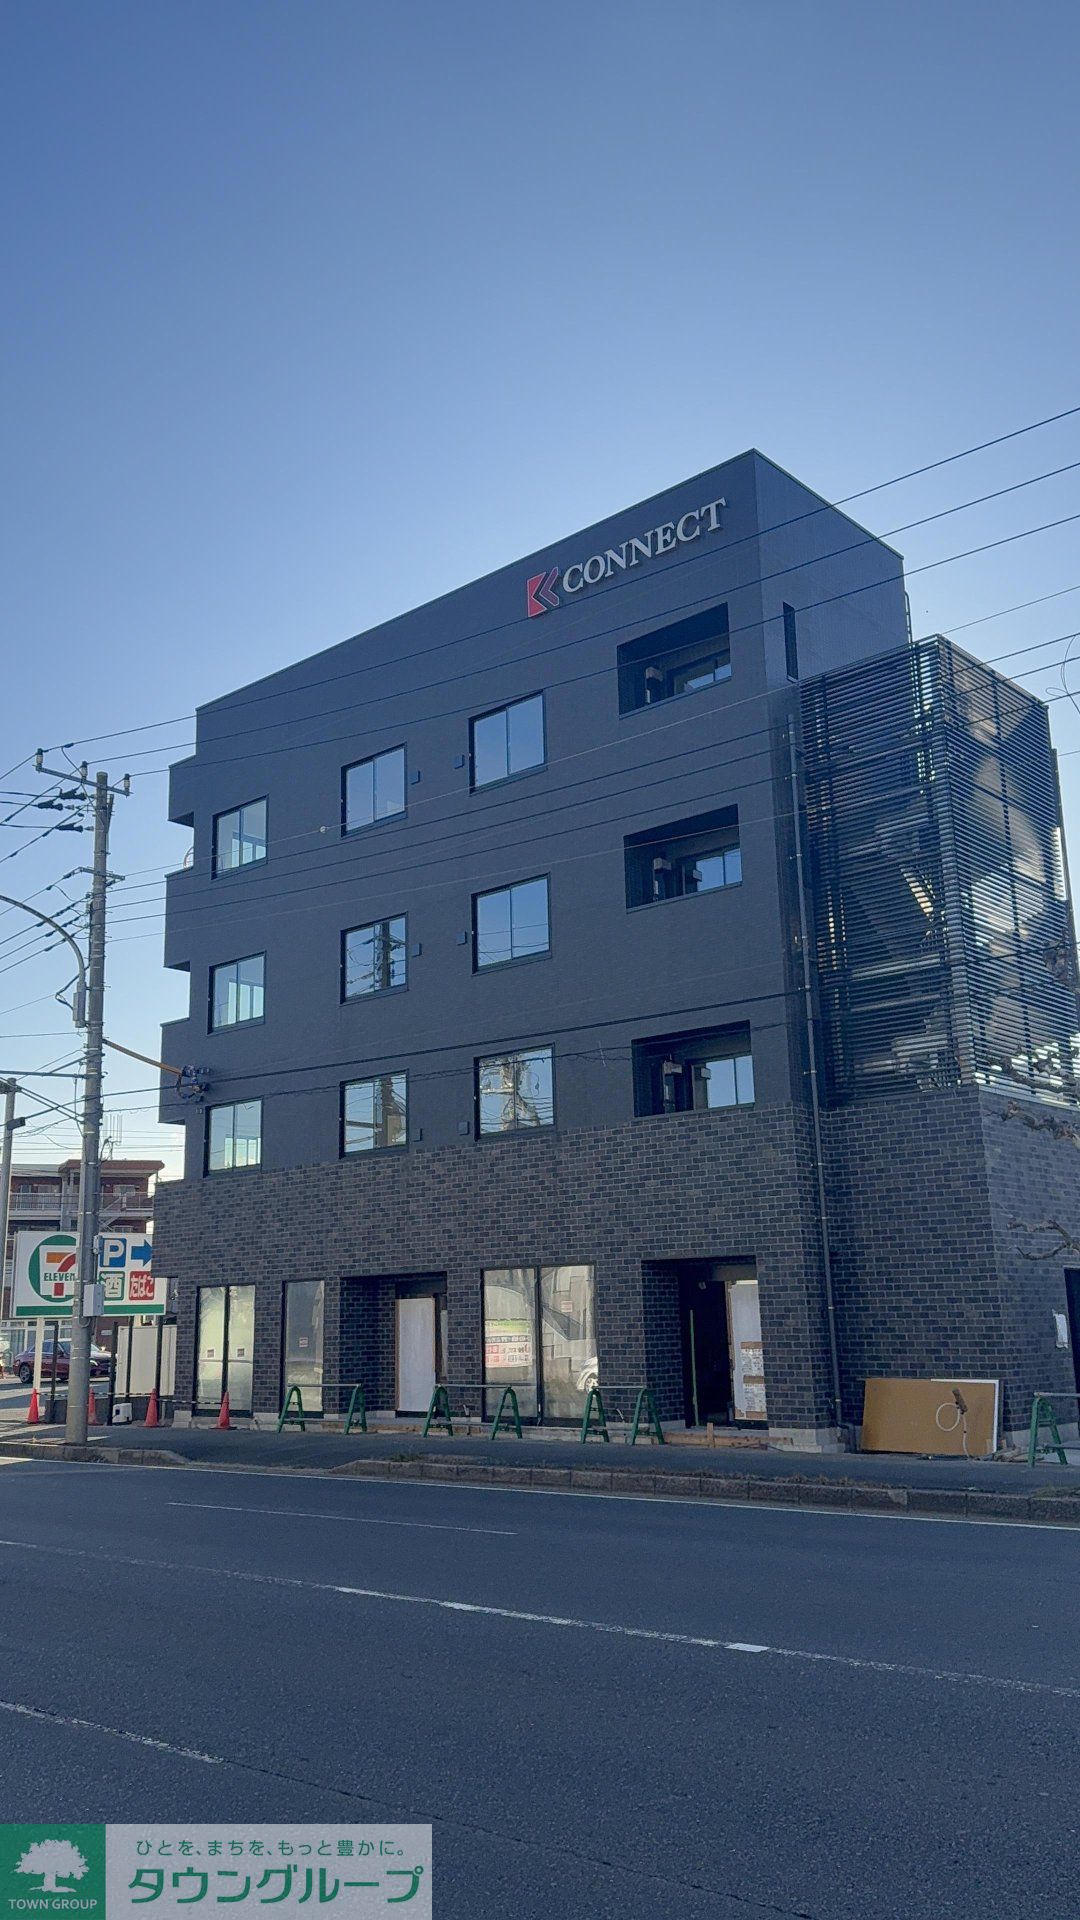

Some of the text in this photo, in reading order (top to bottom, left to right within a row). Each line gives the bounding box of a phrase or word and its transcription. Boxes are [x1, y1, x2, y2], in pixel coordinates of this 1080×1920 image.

[563, 497, 727, 593] CONNECT
[103, 1239, 124, 1266] P
[131, 1274, 153, 1297] たばこ
